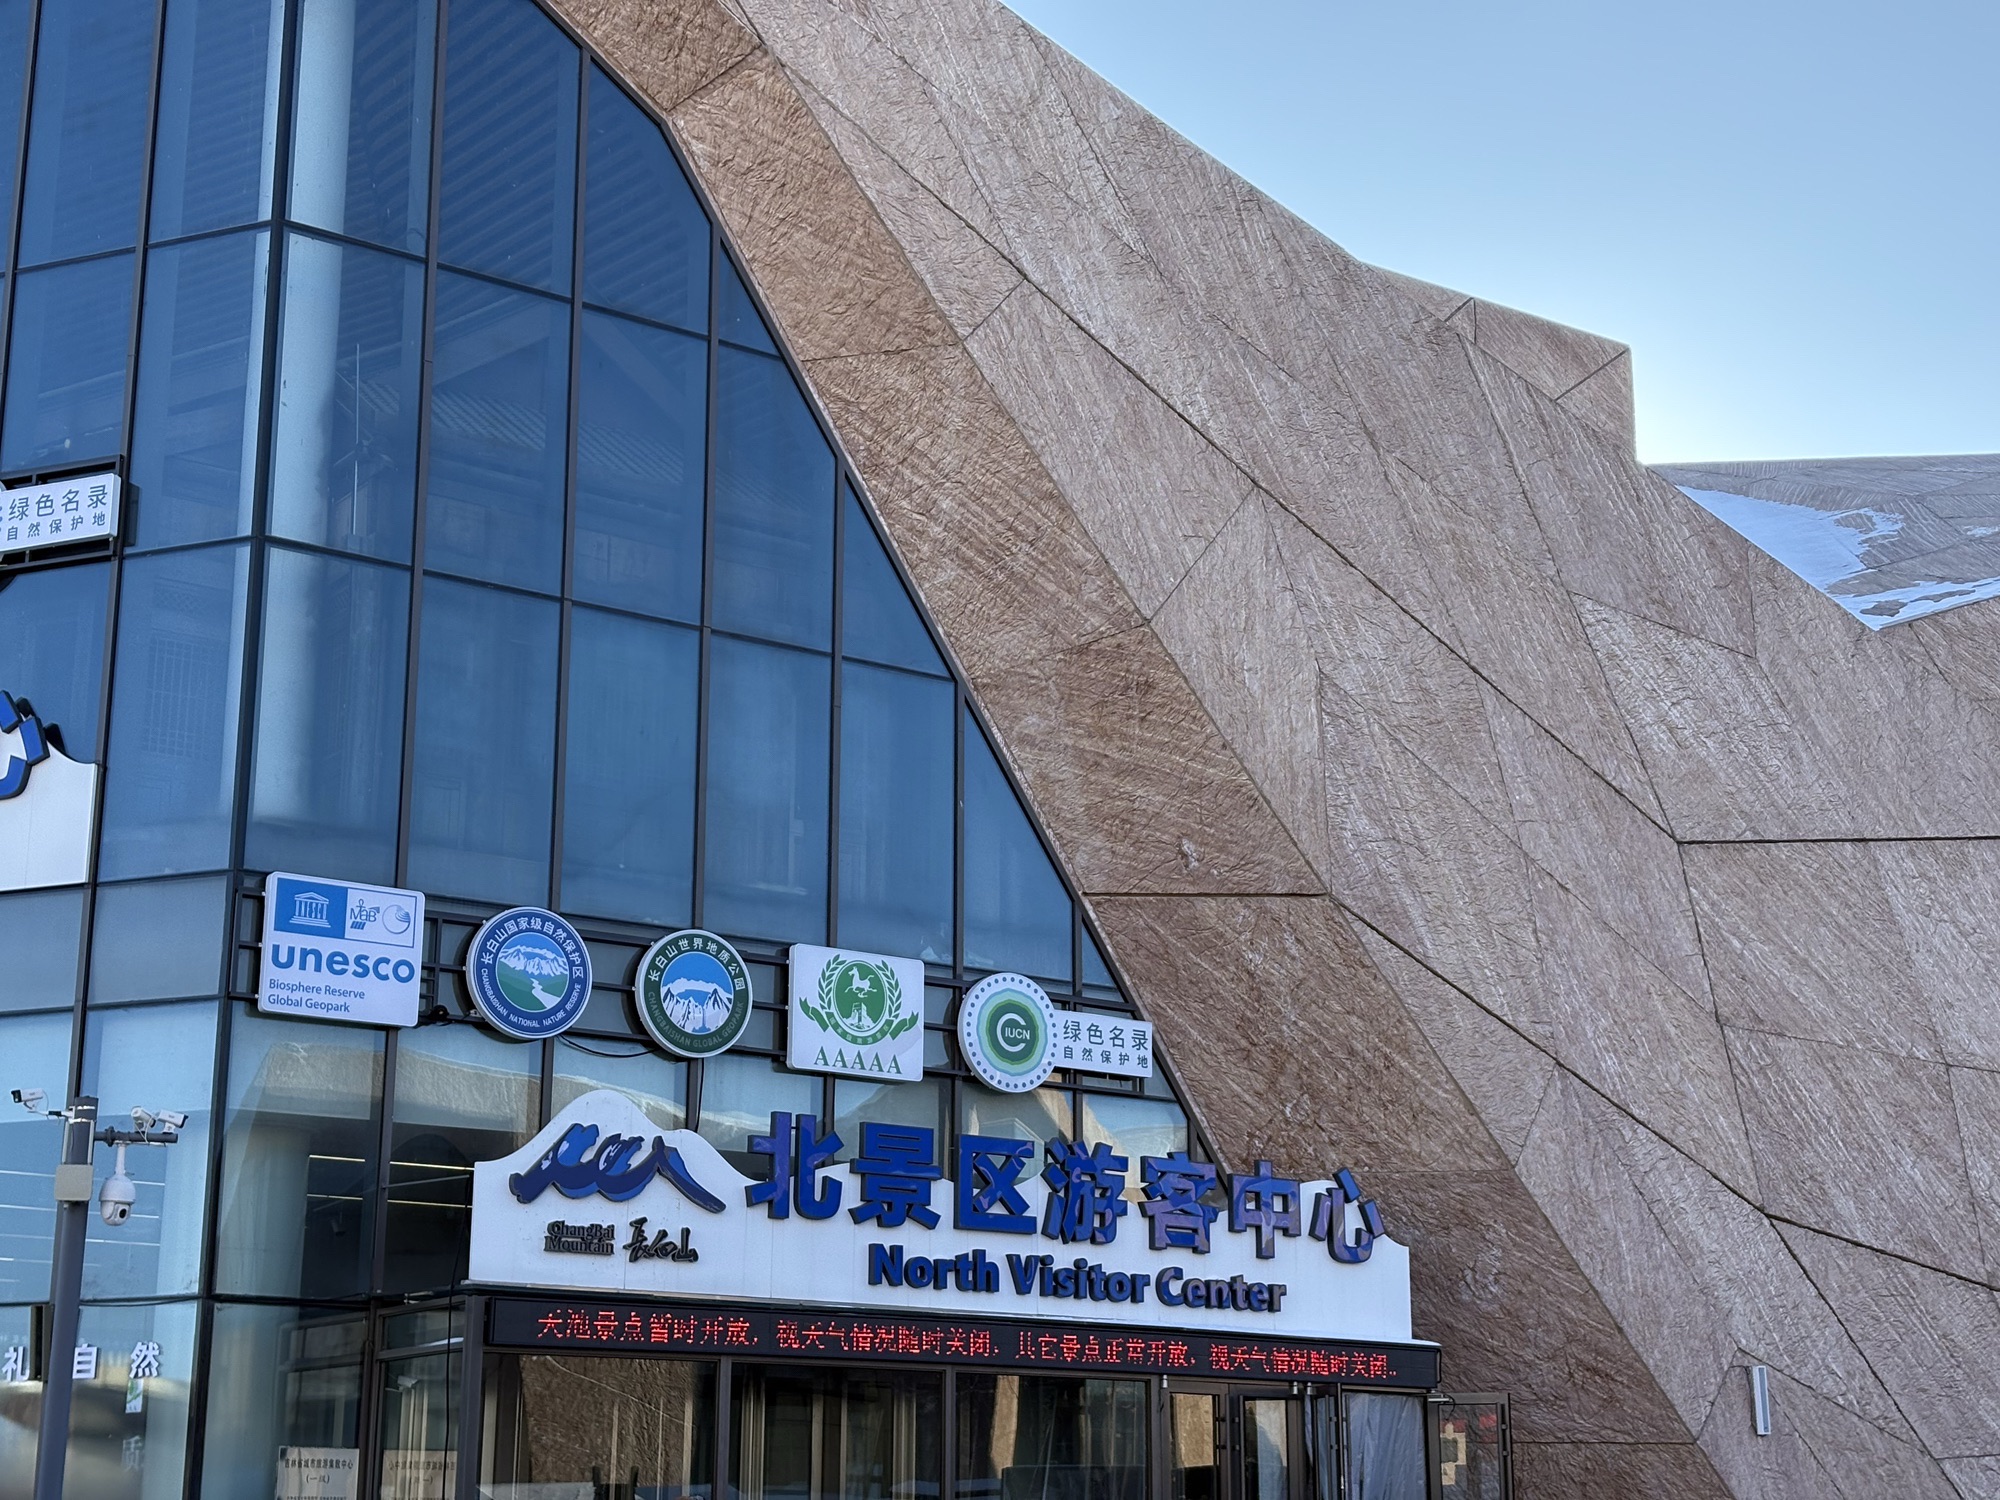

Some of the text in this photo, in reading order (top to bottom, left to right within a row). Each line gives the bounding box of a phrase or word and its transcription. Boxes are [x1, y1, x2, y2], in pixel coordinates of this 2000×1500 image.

[8, 484, 107, 521] 绿色名录
[7, 511, 105, 541] 自然保护地
[271, 944, 415, 983] unesco
[481, 917, 584, 979] 长白山国家级自然保护区
[648, 937, 746, 990] 长白山世界地质公园
[268, 994, 350, 1013] Global Geopark
[269, 978, 366, 999] Biosphere Reserve
[481, 968, 582, 1028] CHANGBAISHAN NATIONAL NATURE RESERVE
[648, 991, 744, 1048] CHANGBAISHAN GLOBAL GEOPARK
[1004, 1027, 1031, 1040] IUCN
[1063, 1019, 1149, 1051] 绿色名录
[814, 1046, 902, 1075] AAAAA
[1063, 1046, 1149, 1069] 自然保护地
[745, 1111, 1385, 1265] 北景区游客中心
[544, 1236, 615, 1256] Mountain
[547, 1220, 615, 1240] ChangBai
[868, 1242, 1288, 1313] North Visitor Center
